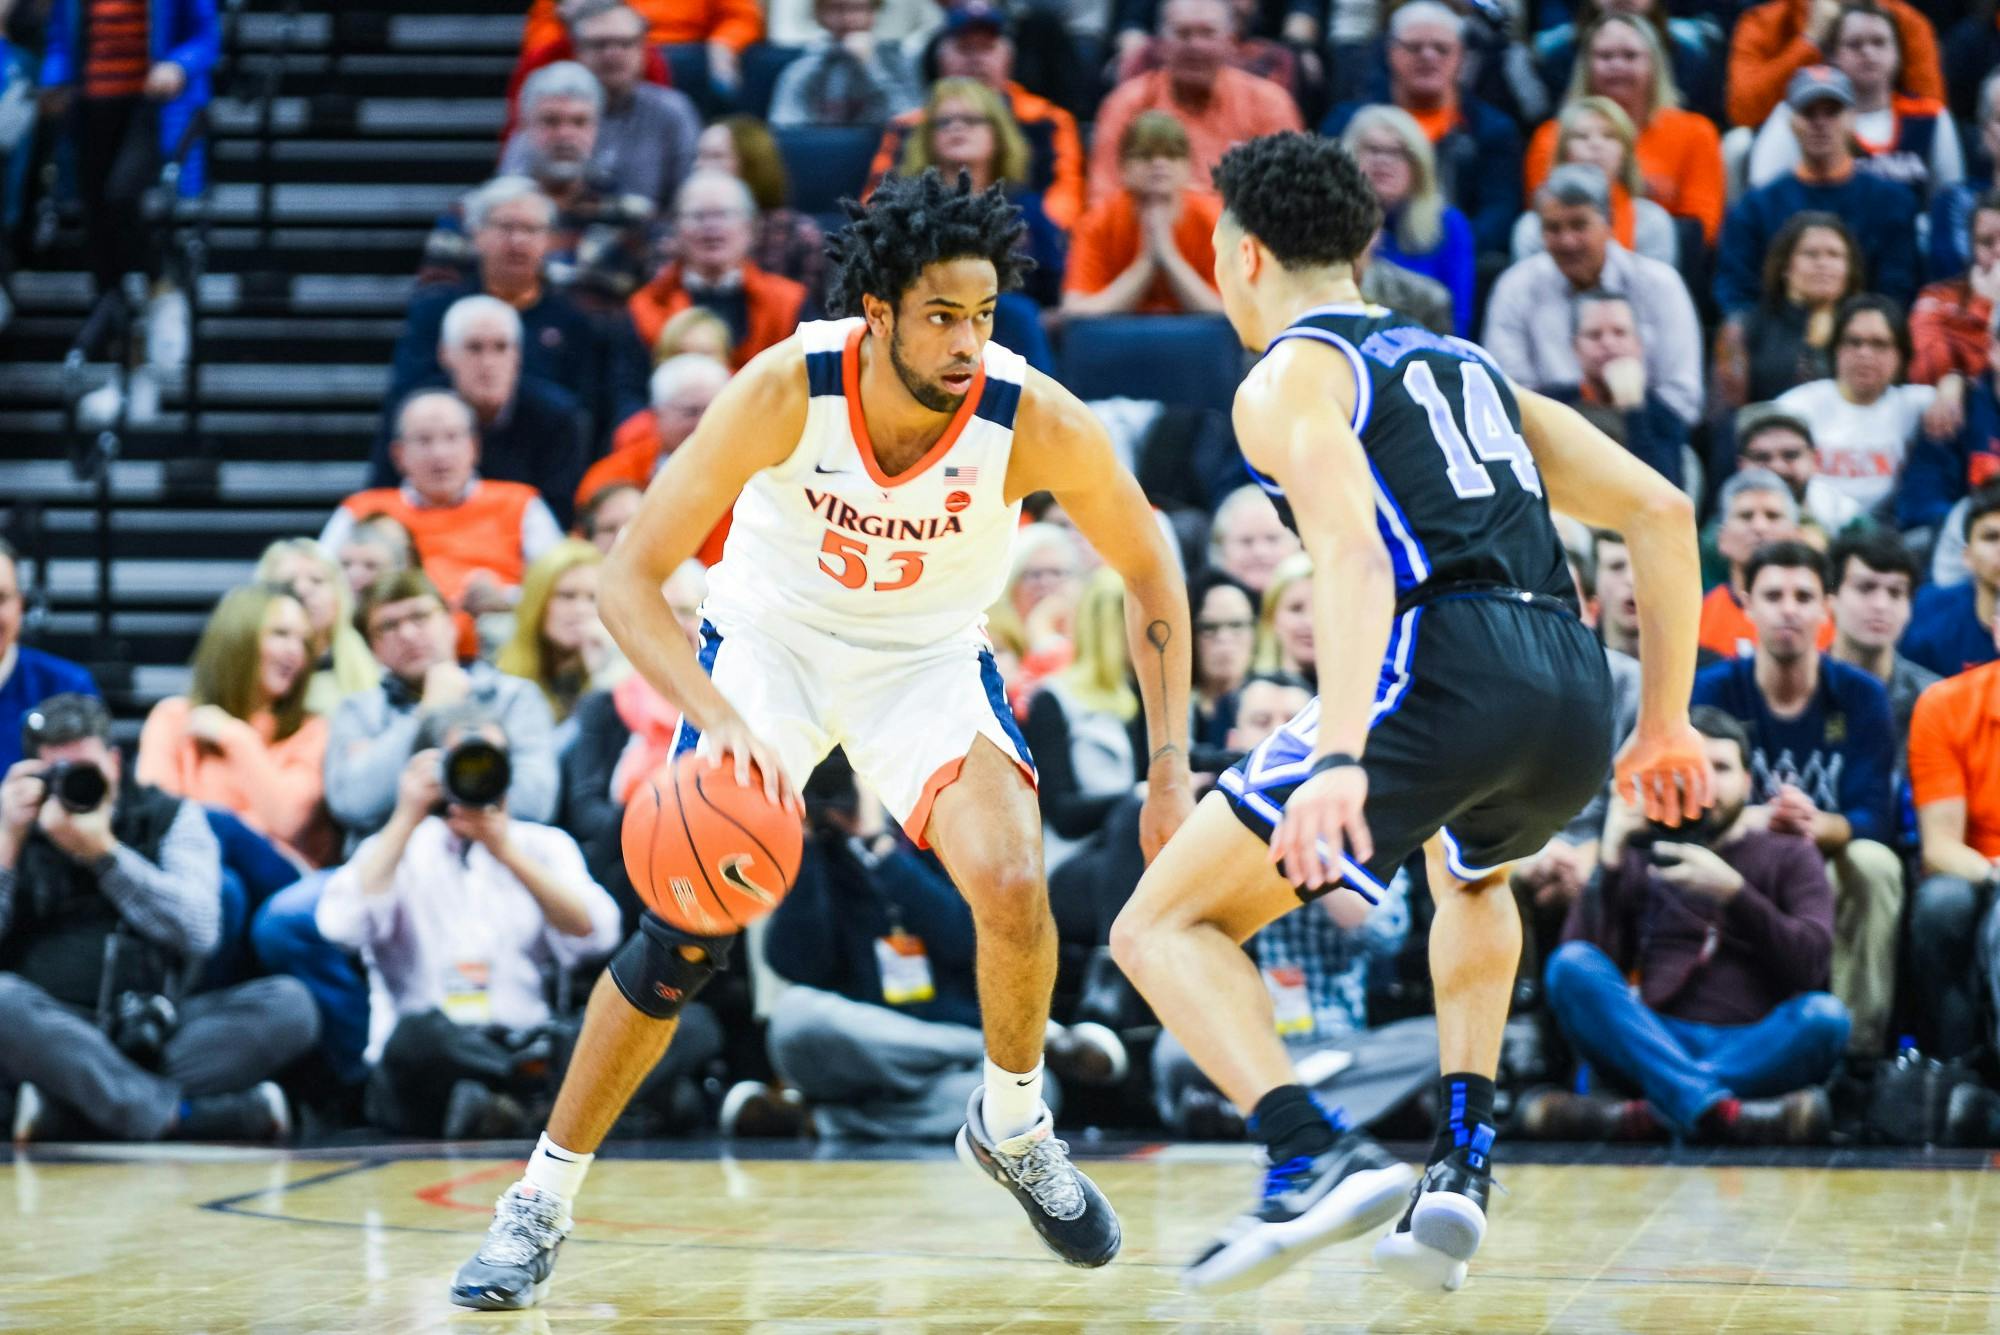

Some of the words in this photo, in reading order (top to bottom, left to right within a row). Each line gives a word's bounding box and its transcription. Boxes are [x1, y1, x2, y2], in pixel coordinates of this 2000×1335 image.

[1402, 360, 1543, 499] 14
[804, 487, 963, 541] VIRGINIA
[818, 528, 928, 592] 53
